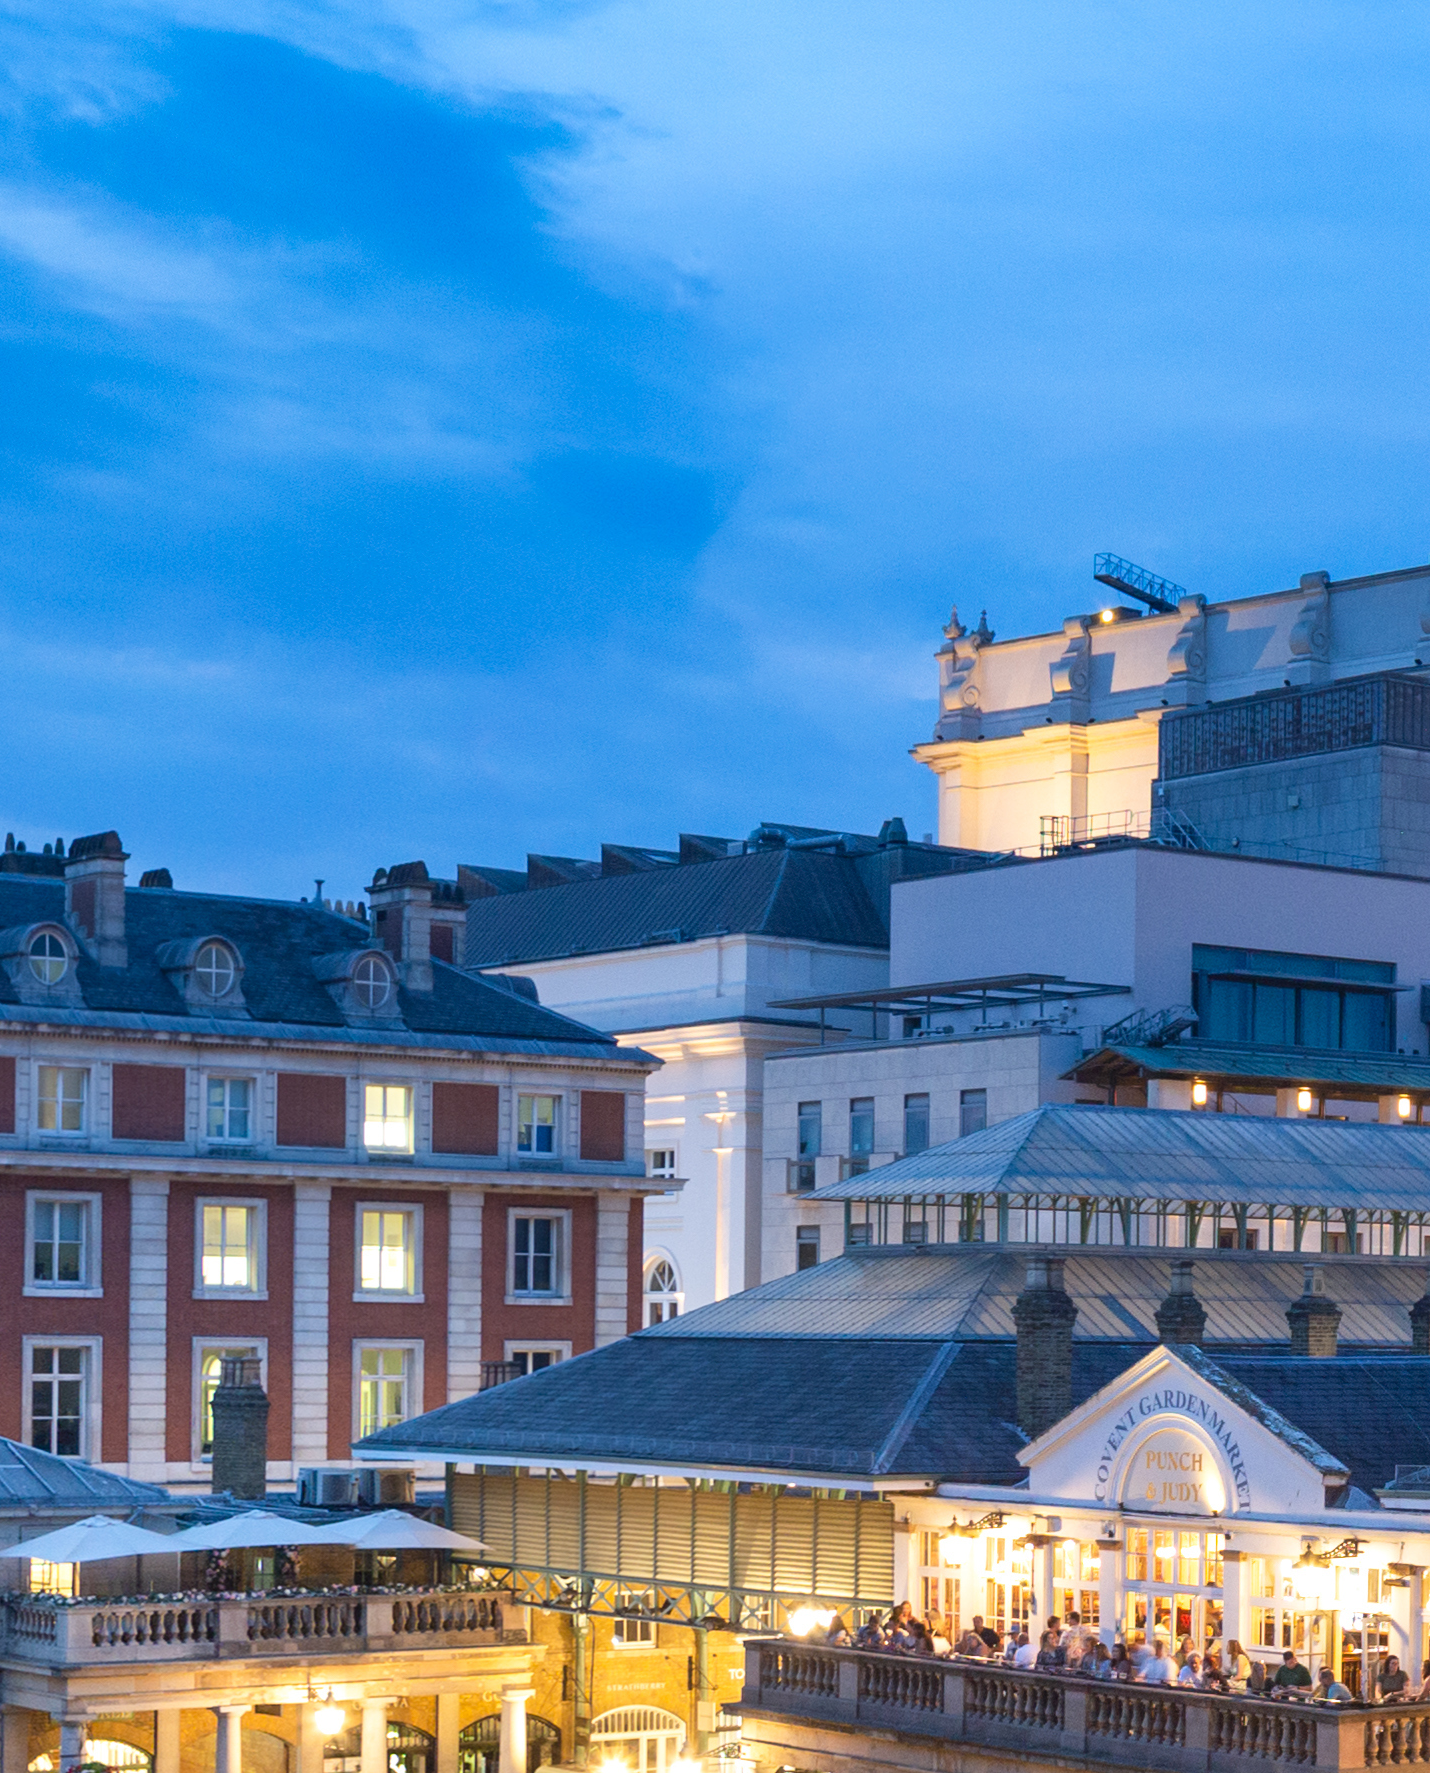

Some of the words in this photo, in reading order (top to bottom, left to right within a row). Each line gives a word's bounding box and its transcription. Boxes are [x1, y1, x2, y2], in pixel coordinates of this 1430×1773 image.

[1095, 1407, 1136, 1501] COVENT
[1139, 1390, 1211, 1420] GARDEN
[1208, 1410, 1252, 1514] MARKET
[1146, 1450, 1203, 1472] PUNCH
[1145, 1482, 1157, 1500] &
[1159, 1482, 1203, 1504] JUDY
[606, 1682, 667, 1692] STRATHBERRY
